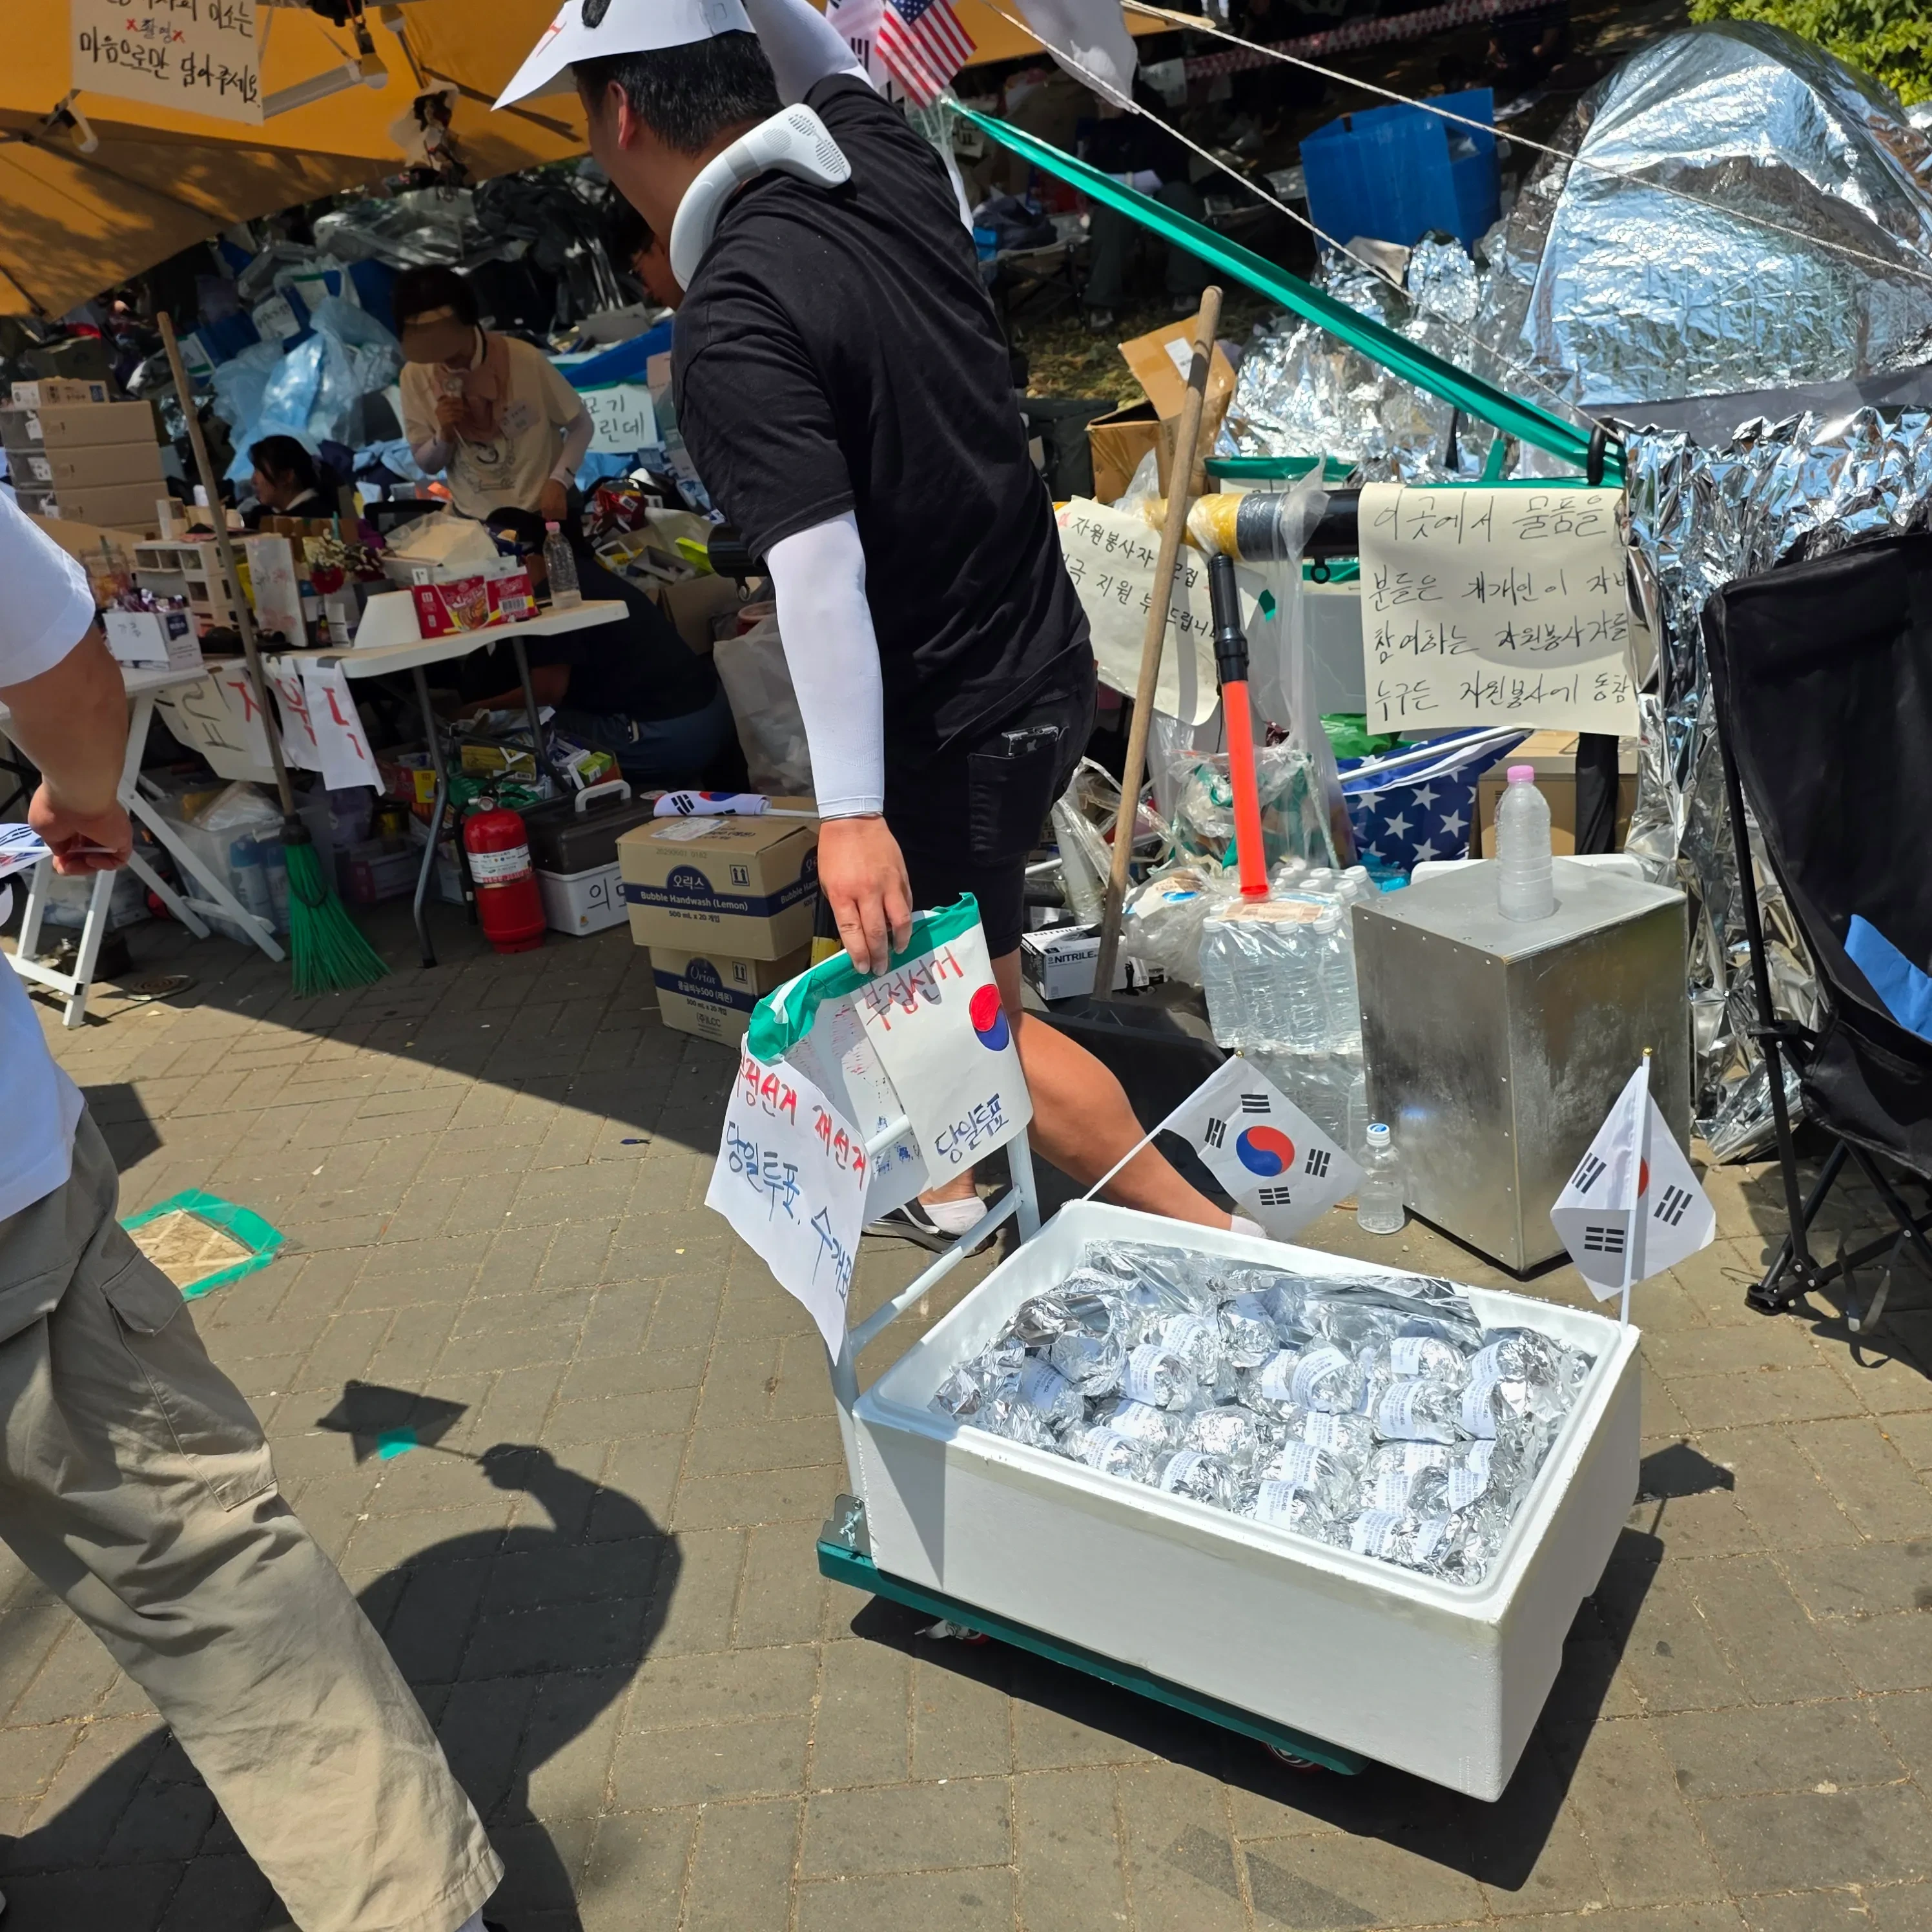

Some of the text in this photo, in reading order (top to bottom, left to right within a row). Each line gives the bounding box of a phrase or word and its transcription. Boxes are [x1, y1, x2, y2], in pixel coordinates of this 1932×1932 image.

[79, 26, 170, 80] 마음으로만
[1071, 517, 1155, 568] 자원봉사자
[1374, 620, 1479, 665] 참여하는
[1375, 679, 1439, 722] 누구든
[641, 890, 749, 911] Bubble Handwash (Lemon)
[673, 874, 705, 890] 오릭스
[780, 885, 803, 905] Bubble
[669, 910, 682, 918] 500
[699, 913, 708, 921] 20
[859, 945, 965, 1032] 부정선거
[934, 1093, 1009, 1165] 당일투표
